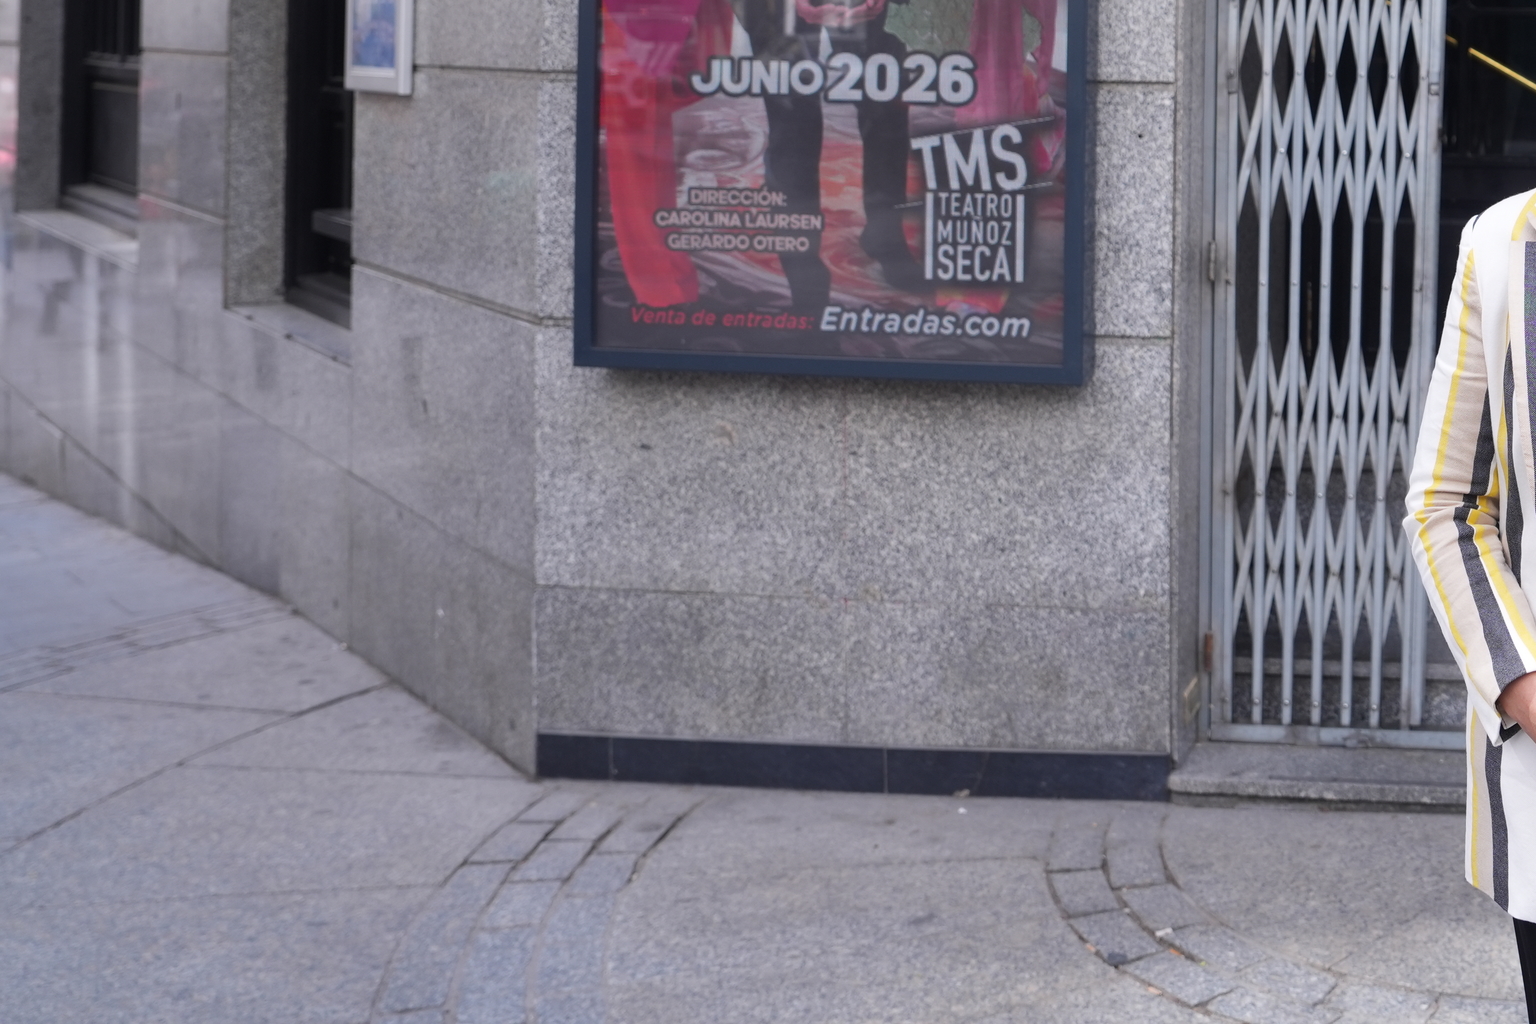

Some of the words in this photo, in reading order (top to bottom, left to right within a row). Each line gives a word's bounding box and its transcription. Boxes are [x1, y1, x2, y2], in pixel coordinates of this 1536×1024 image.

[691, 57, 823, 95] JUNIO
[827, 52, 975, 103] 2026
[910, 124, 1027, 191] TMS
[690, 187, 787, 206] DIRECCIÓN:
[938, 192, 1013, 218] TEATRO
[655, 211, 741, 227] CAROLINA
[745, 213, 822, 229] LAURSEN
[937, 216, 1012, 246] MUÑOZ
[668, 233, 749, 250] GERARDO
[753, 235, 810, 251] OTERO
[937, 244, 1011, 282] SECA
[630, 307, 685, 326] Venta
[692, 309, 716, 327] de
[722, 313, 815, 330] entradas:
[820, 306, 1031, 338] Entradas.com
